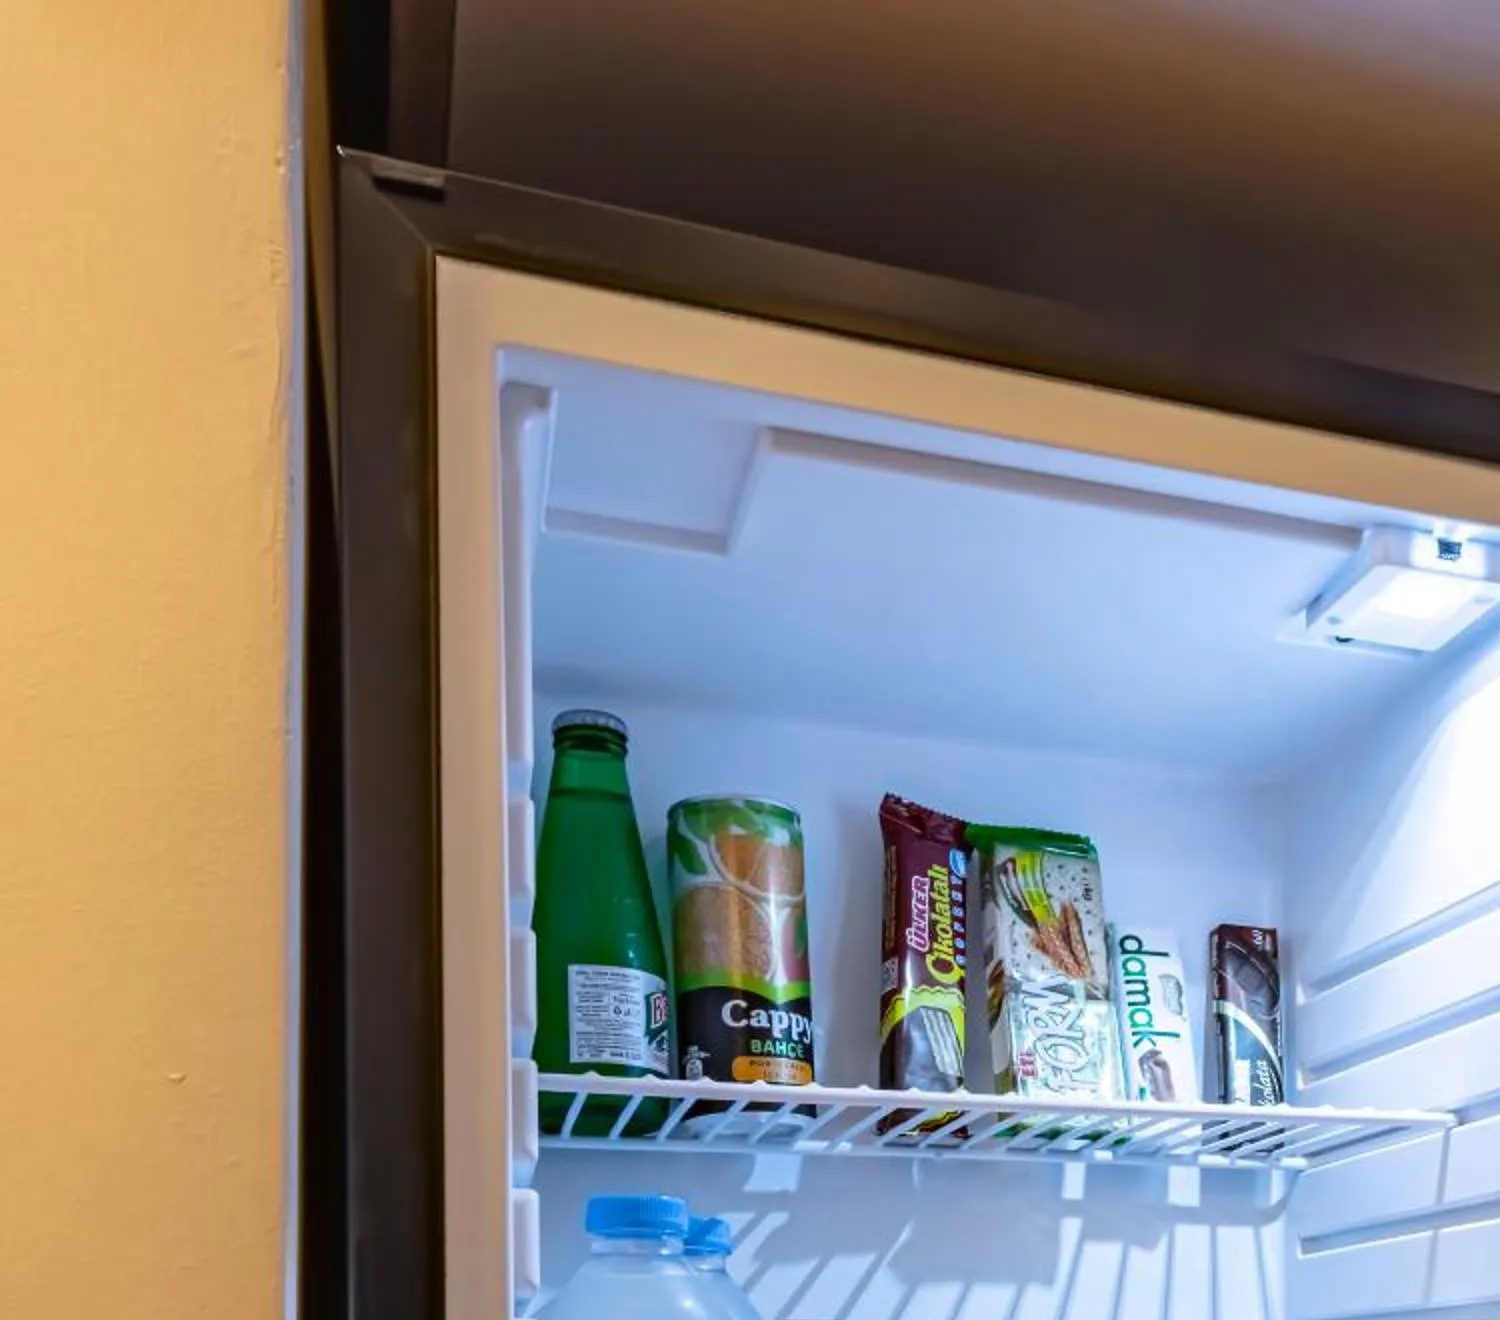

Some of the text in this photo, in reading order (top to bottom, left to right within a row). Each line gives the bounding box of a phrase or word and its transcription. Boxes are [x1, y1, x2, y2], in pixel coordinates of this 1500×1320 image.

[906, 875, 930, 952] ÜLKER
[722, 1000, 812, 1045] Cappy
[1119, 934, 1181, 1048] damak
